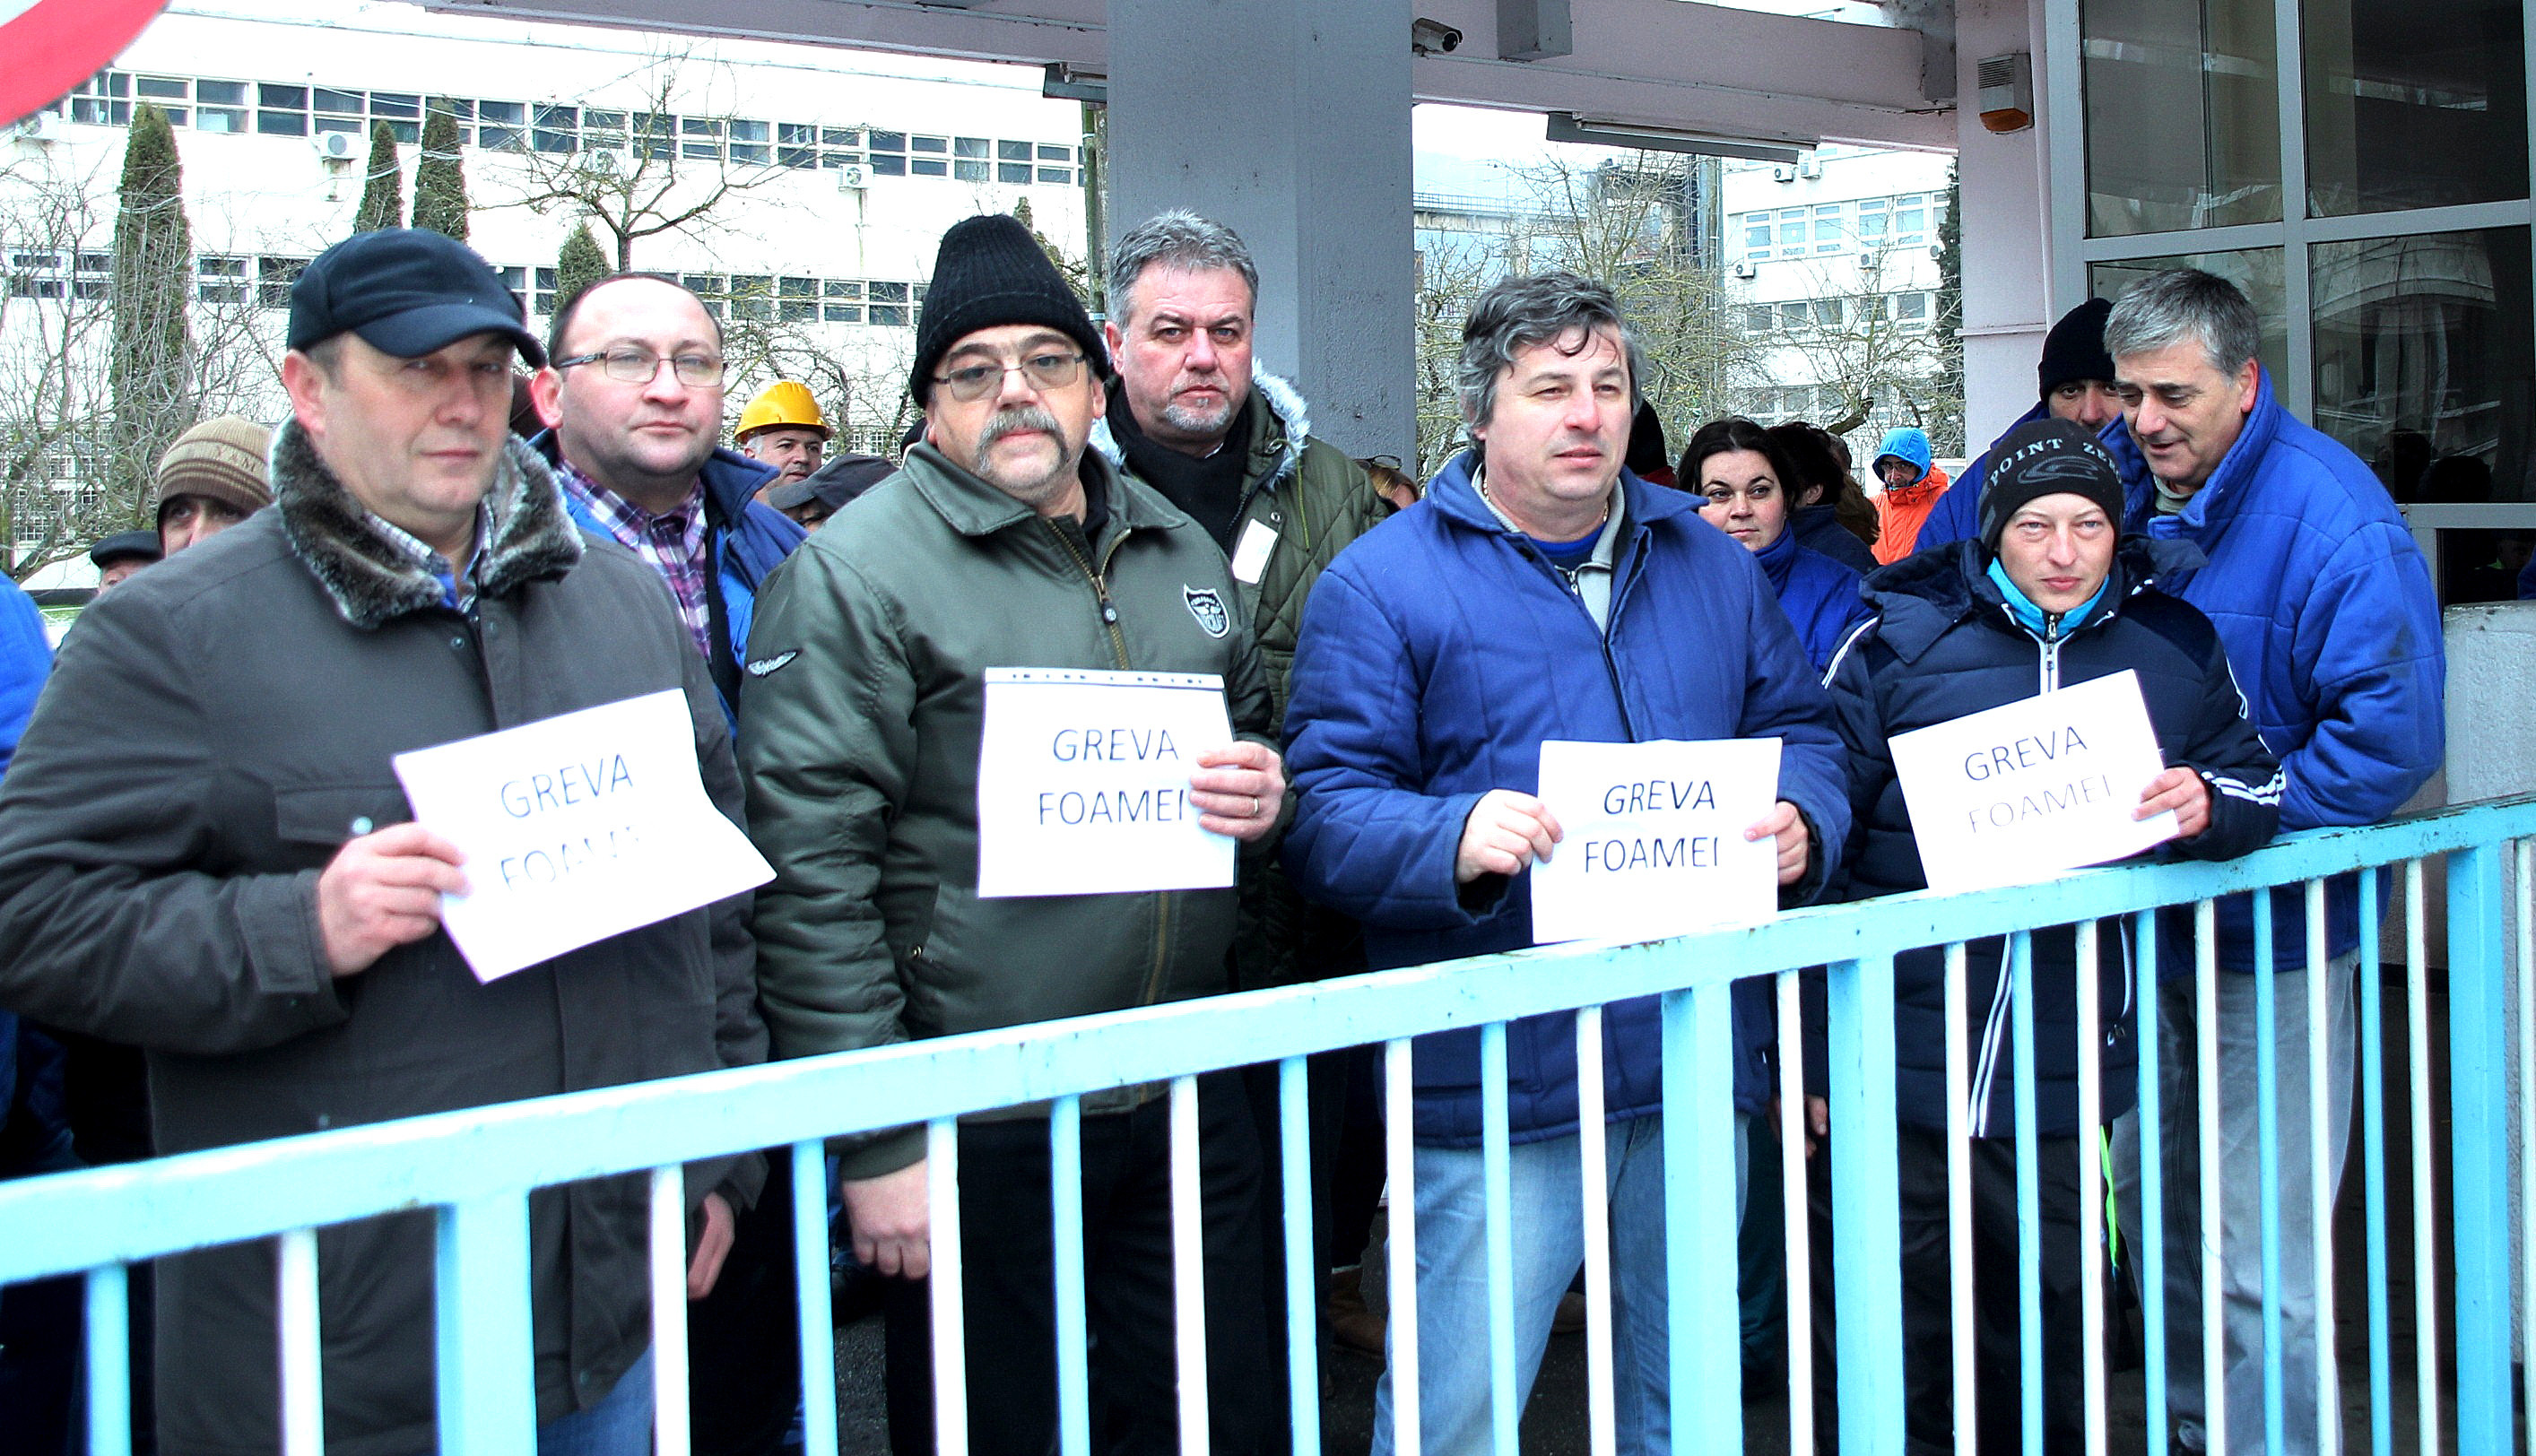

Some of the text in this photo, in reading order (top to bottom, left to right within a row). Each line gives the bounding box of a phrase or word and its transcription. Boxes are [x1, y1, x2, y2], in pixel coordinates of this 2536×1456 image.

[1989, 438, 2063, 488] POINT
[1052, 728, 1179, 762] GREVA
[1964, 725, 2089, 782] GREVA
[500, 753, 633, 819] GREVA
[1038, 788, 1185, 826] FOAMEI
[1603, 779, 1715, 815] GREVA
[1967, 774, 2112, 834] FOAMEI
[1585, 836, 1719, 873] FOAMEI
